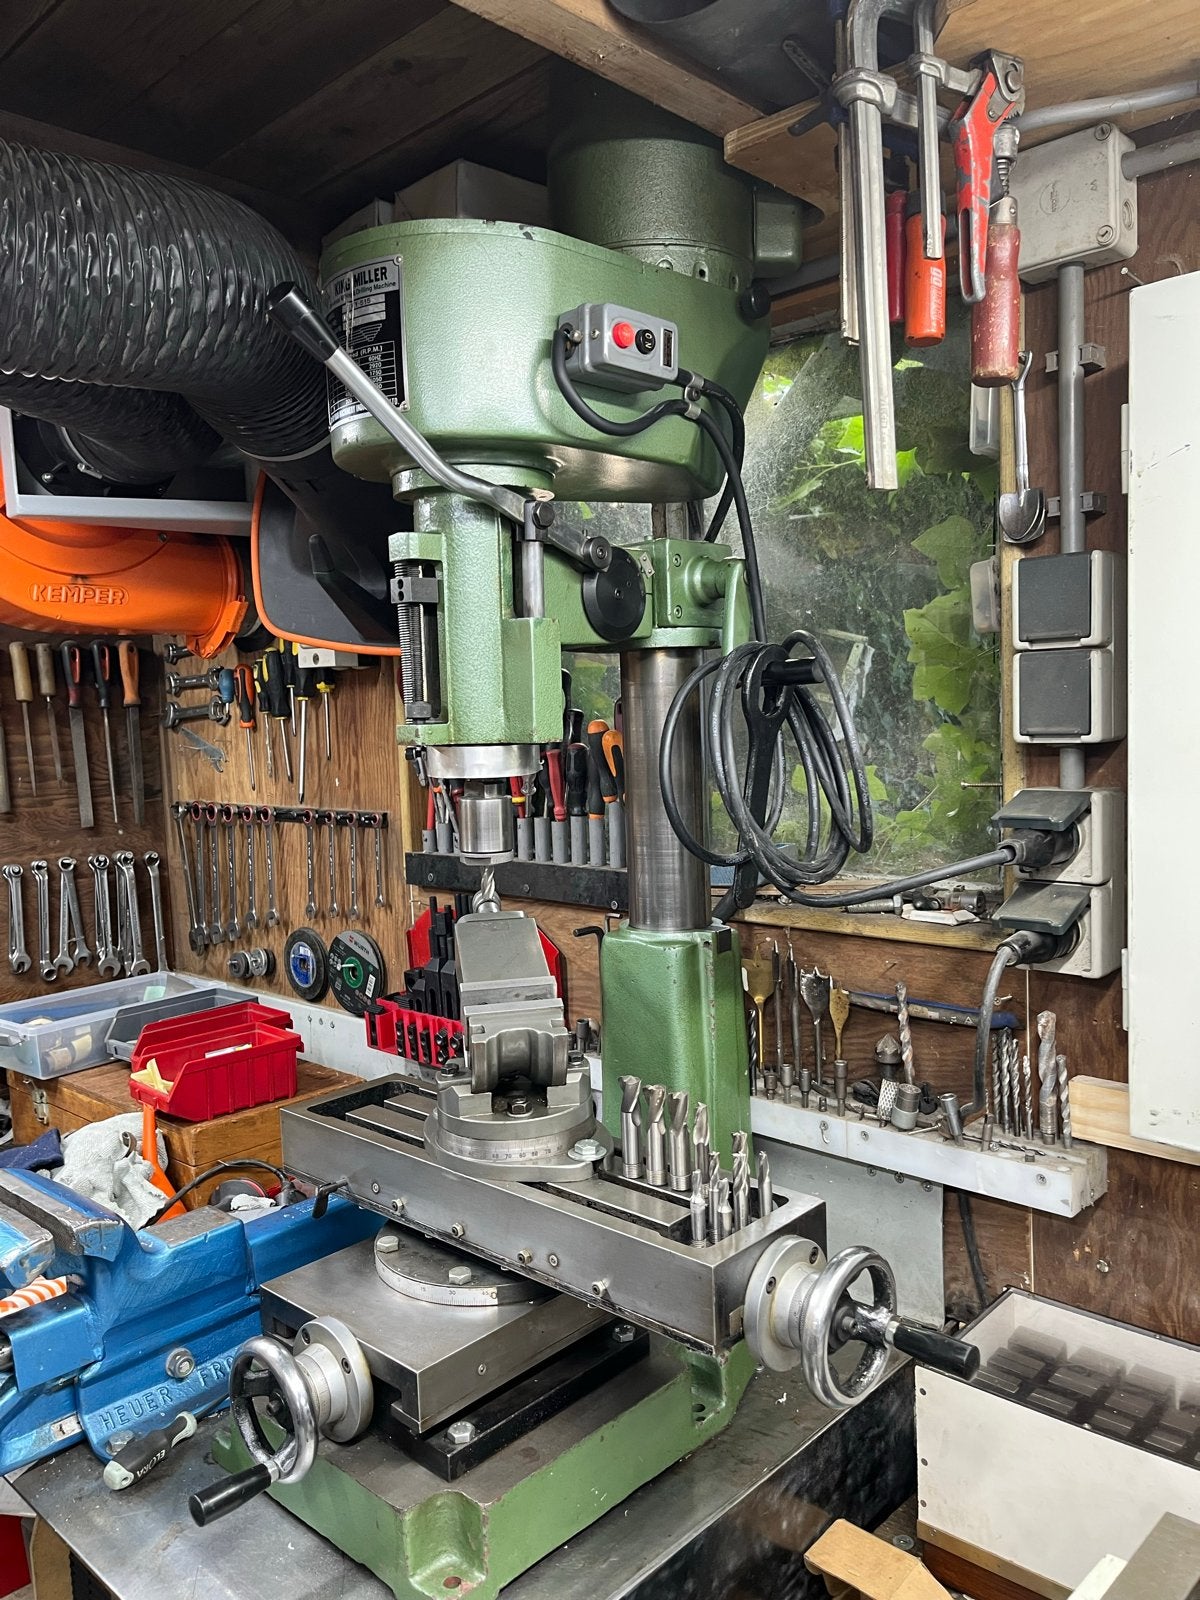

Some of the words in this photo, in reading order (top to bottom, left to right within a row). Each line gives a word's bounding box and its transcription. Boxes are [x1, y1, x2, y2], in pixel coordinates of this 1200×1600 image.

[353, 266, 388, 288] MILLER
[644, 332, 653, 349] ON
[32, 583, 125, 605] KEMPER
[100, 1386, 174, 1431] HEUER
[136, 1449, 166, 1478] ELORA
